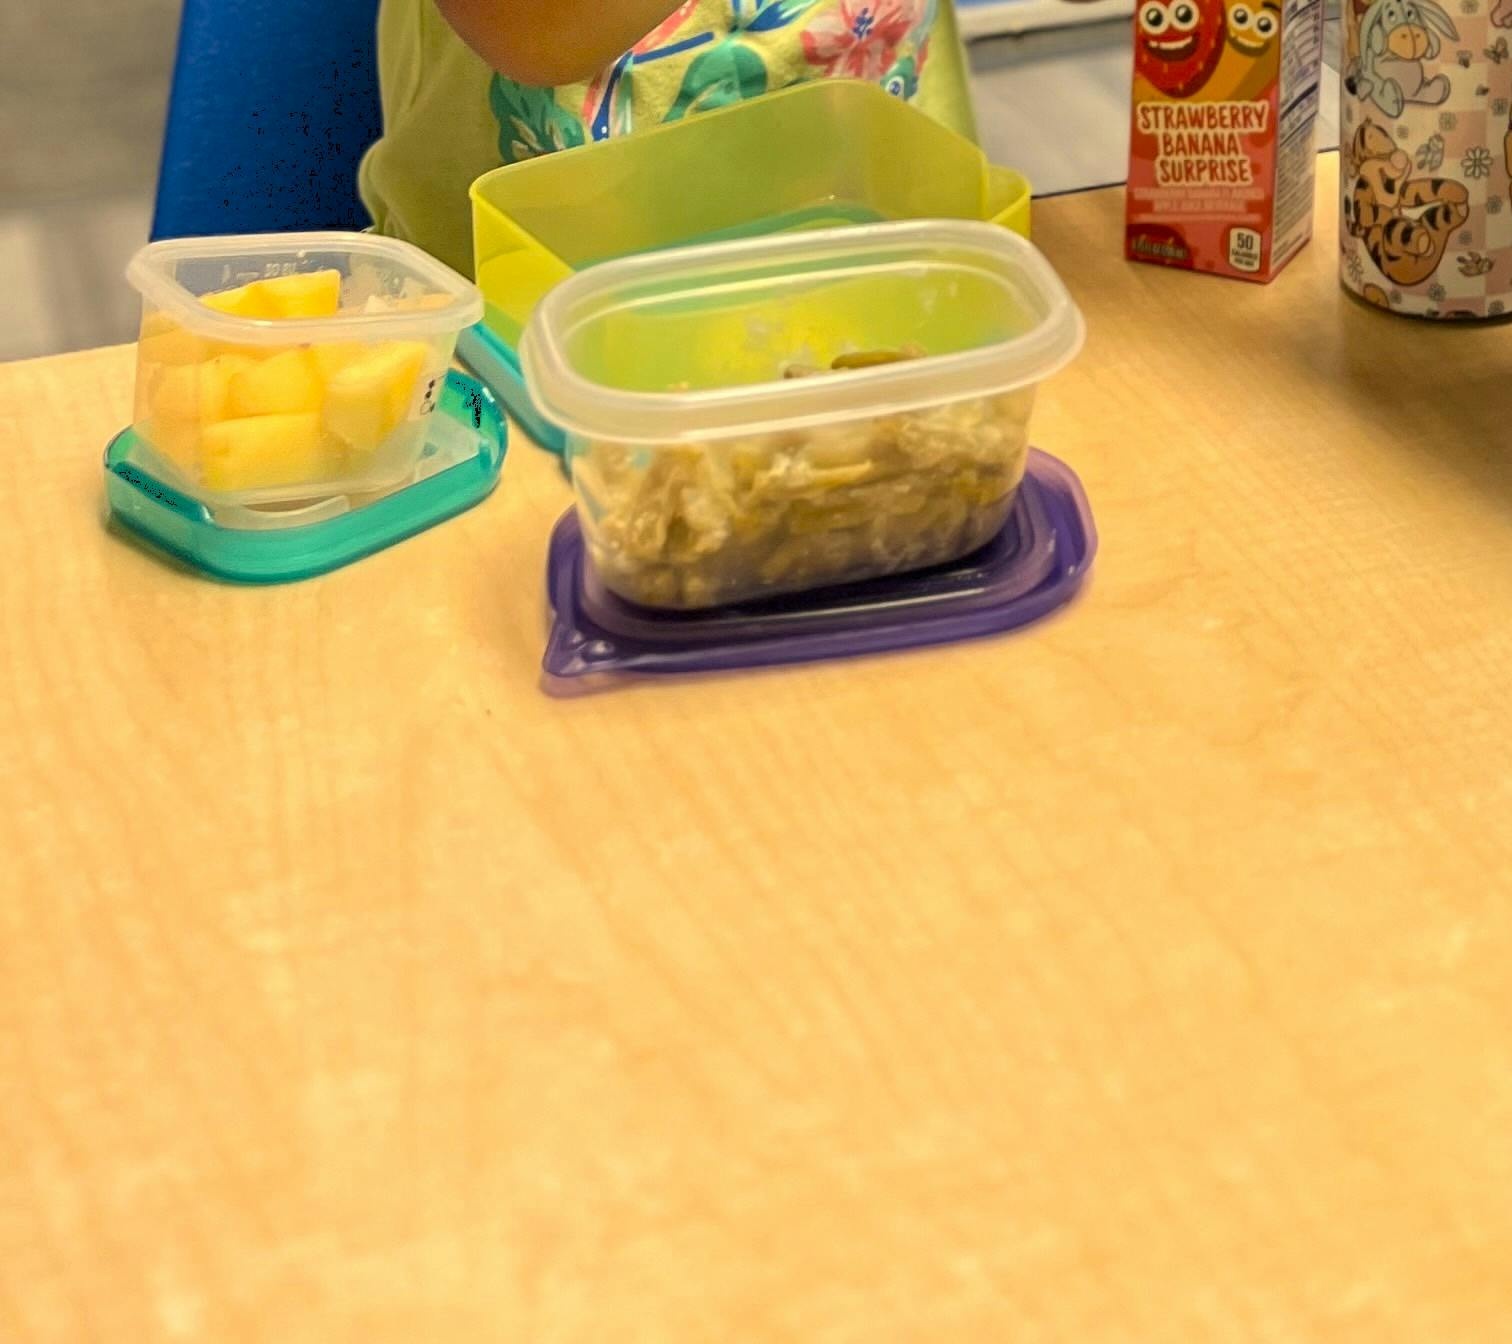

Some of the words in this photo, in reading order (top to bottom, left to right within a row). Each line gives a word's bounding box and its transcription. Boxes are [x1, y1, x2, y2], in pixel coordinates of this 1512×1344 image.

[1140, 102, 1266, 130] STRAWBERRY
[1162, 132, 1239, 156] BANANA
[1160, 158, 1250, 183] SURPRISE
[1237, 232, 1253, 250] 50
